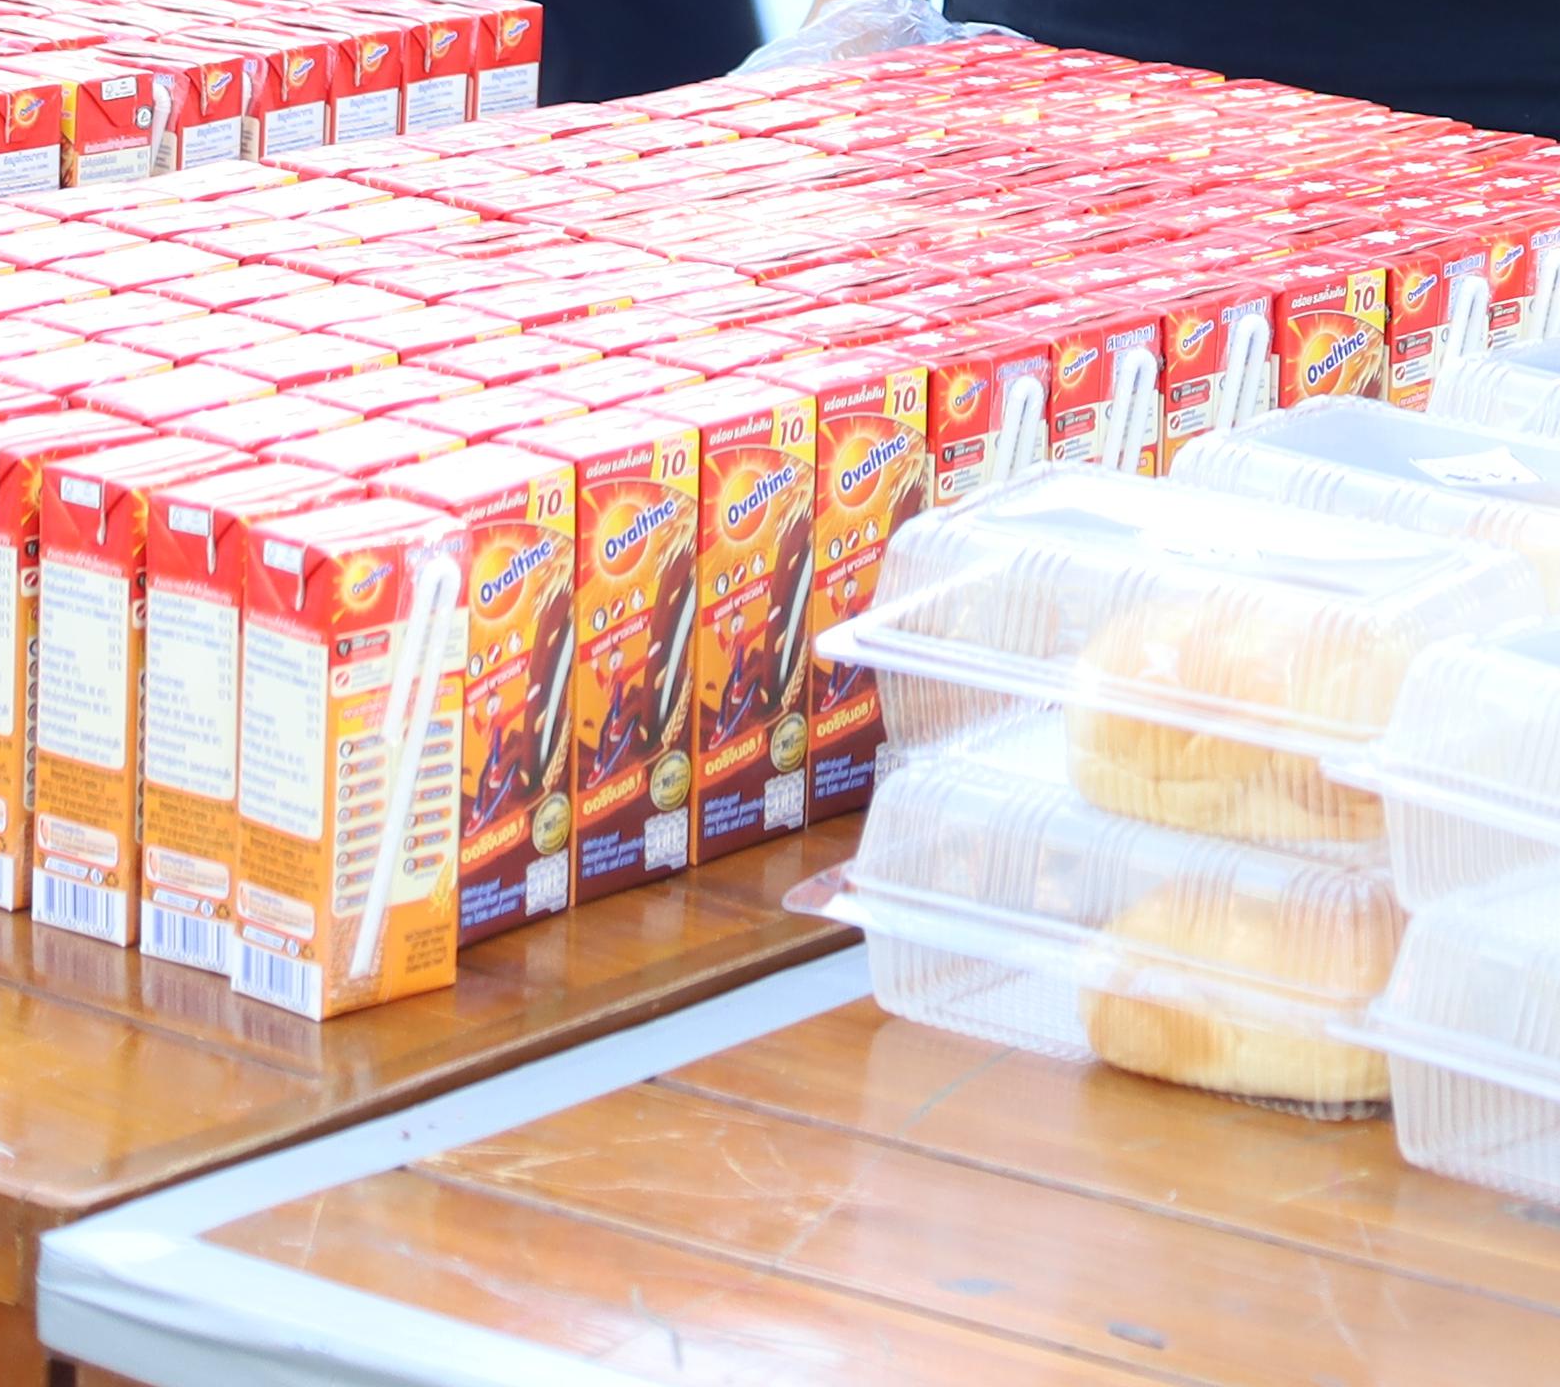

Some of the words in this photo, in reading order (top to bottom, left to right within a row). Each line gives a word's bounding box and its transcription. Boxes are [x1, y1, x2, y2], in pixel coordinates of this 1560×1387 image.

[1353, 286, 1376, 313] 10
[1182, 318, 1215, 349] Ovaltine
[1063, 347, 1099, 377] Ovaltine
[1306, 330, 1369, 387] Ovaltine
[892, 385, 917, 416] 10
[779, 416, 805, 447] 10
[660, 448, 686, 481] 10
[841, 434, 908, 493] Ovaltine
[535, 488, 563, 520] 10
[727, 463, 796, 526] Ovaltine
[605, 498, 677, 562] Ovaltine
[480, 540, 554, 605] Ovaltine
